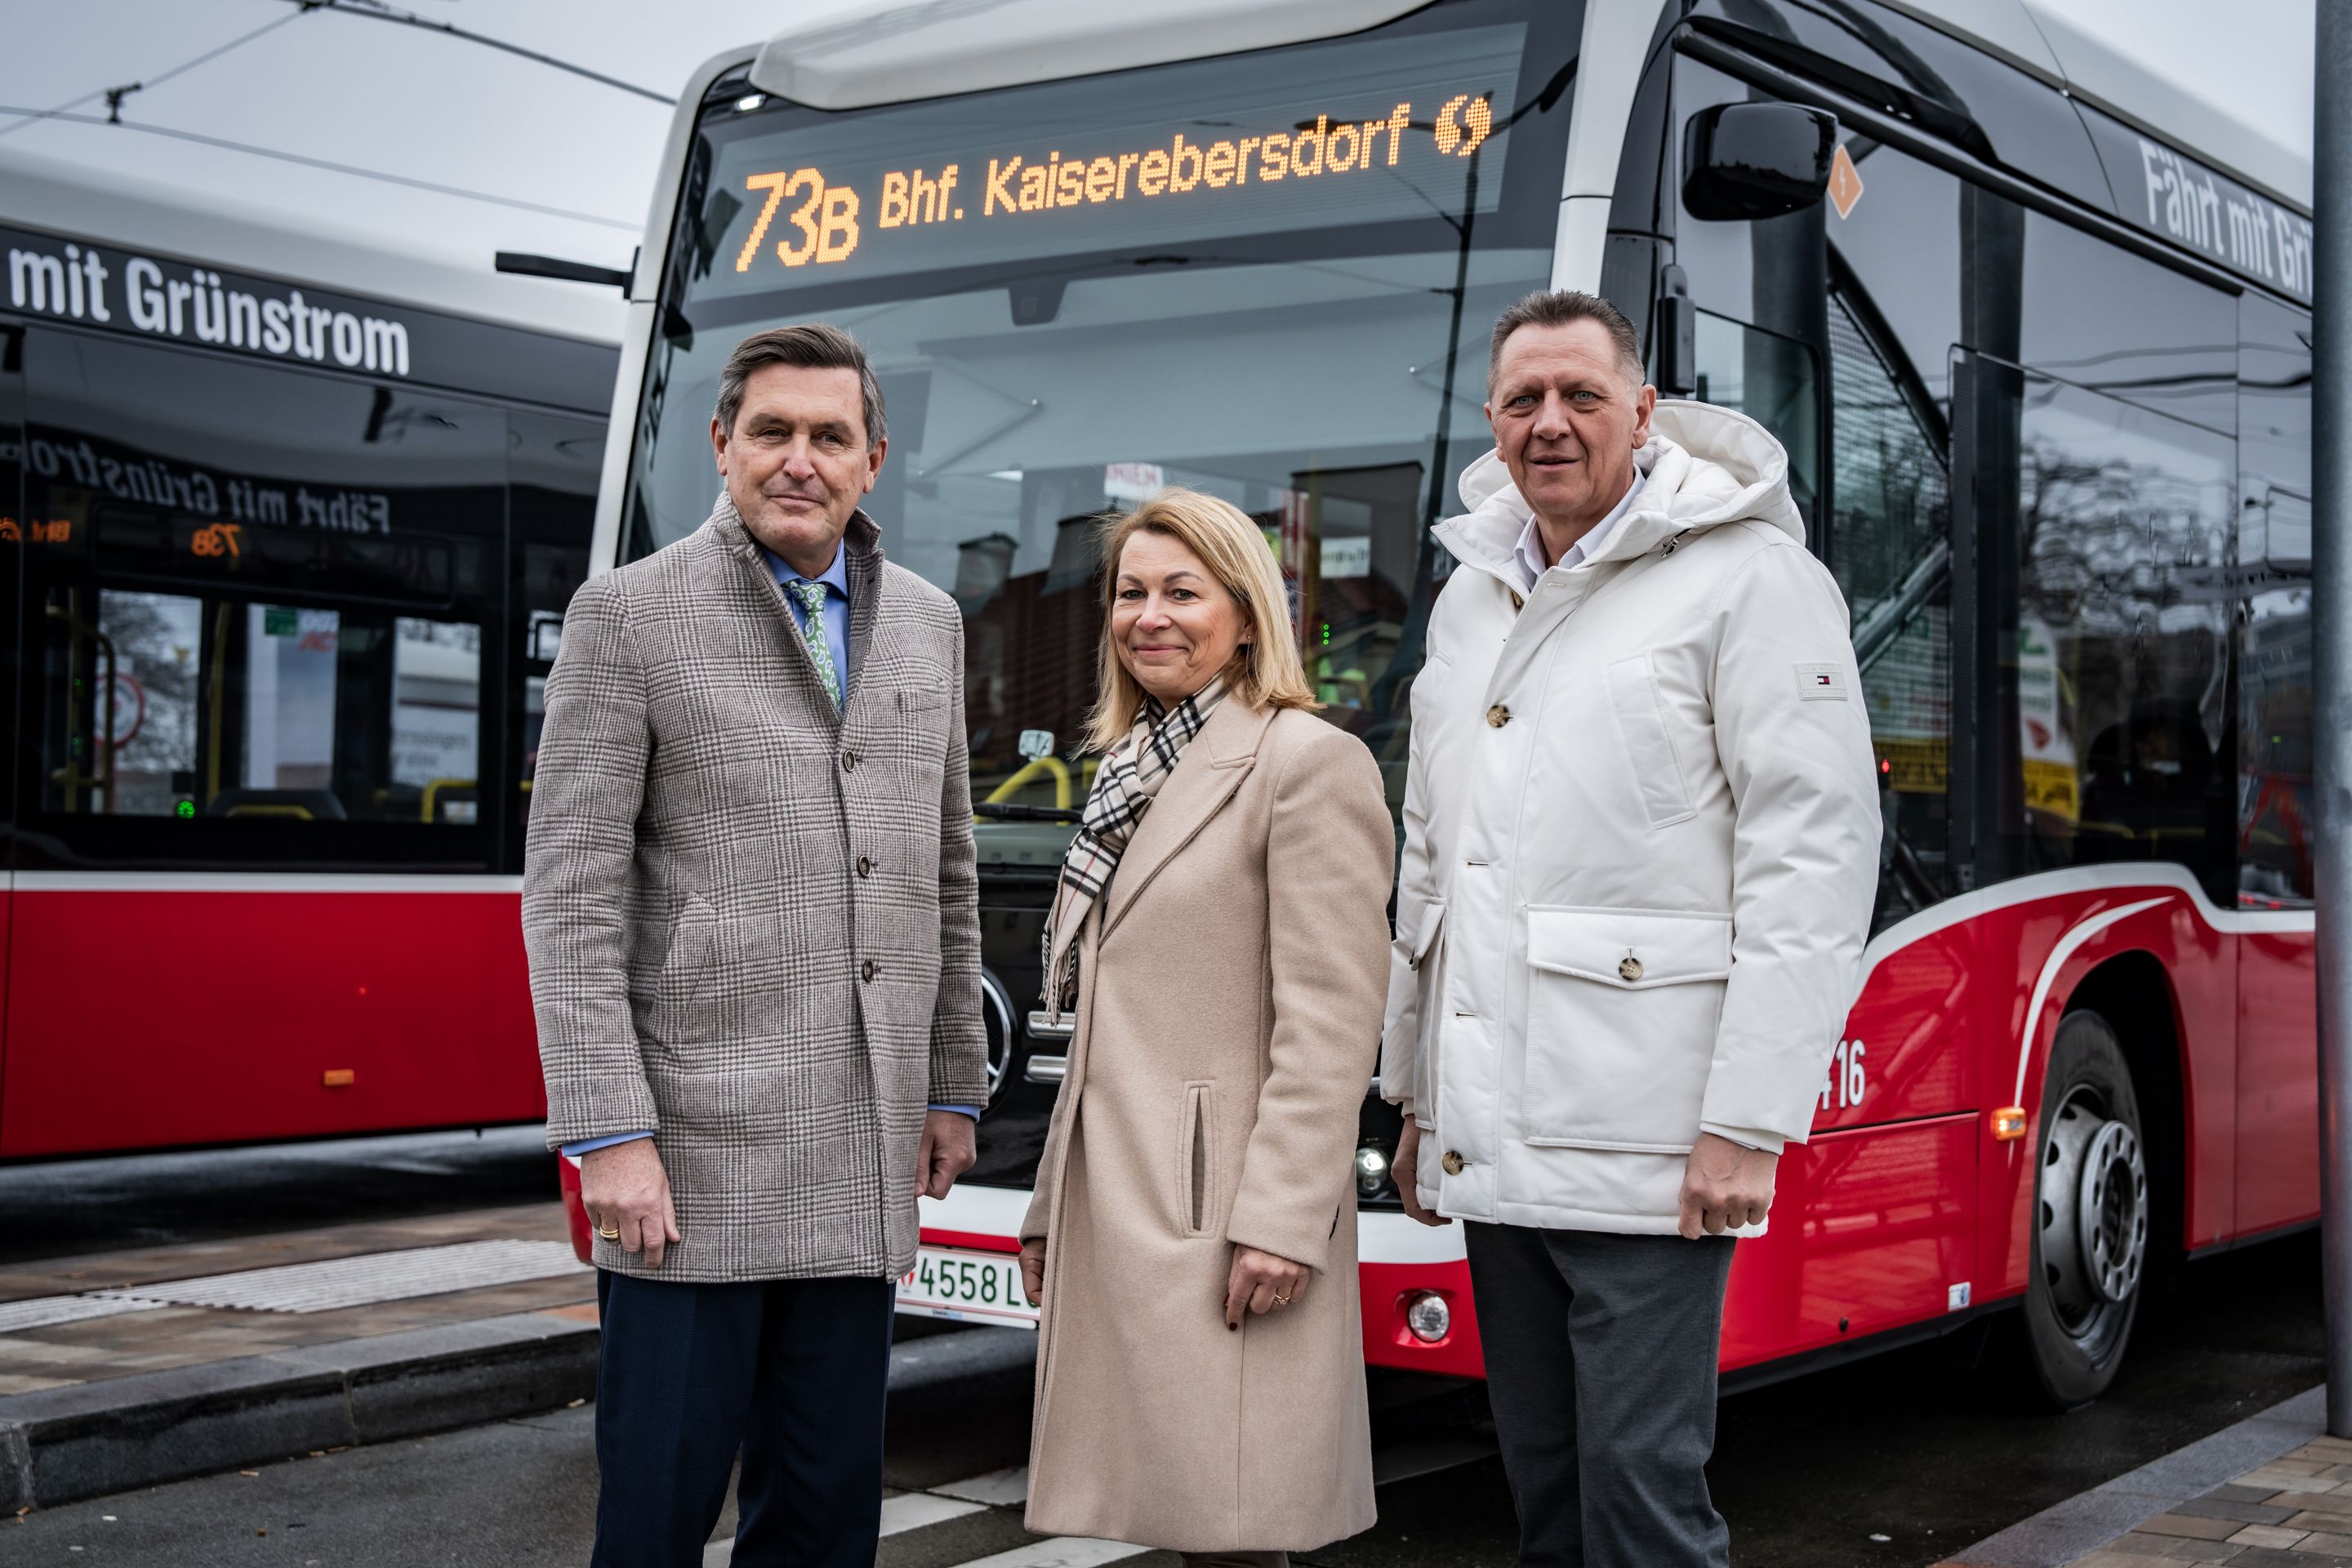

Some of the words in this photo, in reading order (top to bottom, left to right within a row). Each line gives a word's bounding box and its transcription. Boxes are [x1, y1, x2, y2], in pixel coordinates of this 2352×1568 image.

[735, 166, 861, 274] 73B
[878, 163, 964, 229] Bhf.
[982, 102, 1412, 217] Kaiserebersdorf
[2138, 138, 2225, 256] Fährt
[2226, 193, 2274, 280] mit
[8, 245, 111, 322] mit
[125, 256, 410, 376] Grünstrom
